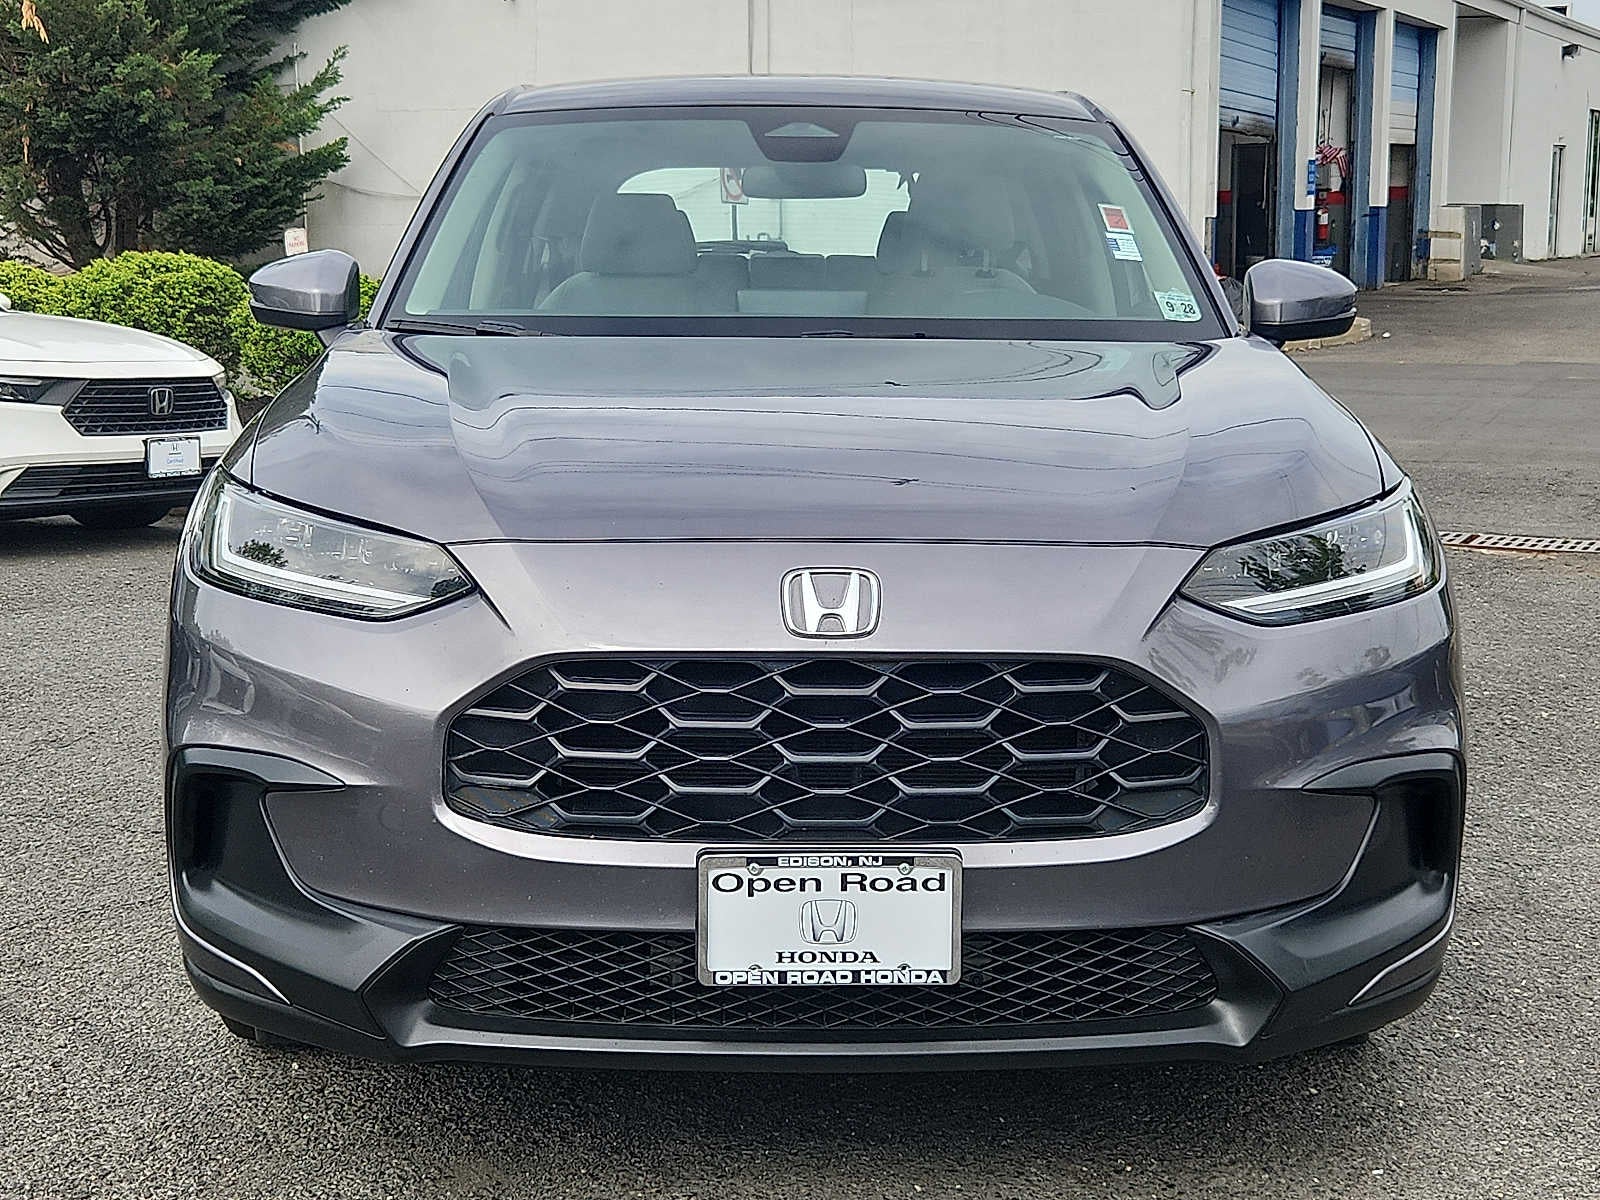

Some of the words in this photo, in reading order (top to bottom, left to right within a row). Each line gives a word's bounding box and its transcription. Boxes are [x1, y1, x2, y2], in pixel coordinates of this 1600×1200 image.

[1165, 300, 1175, 312] 9
[1180, 302, 1196, 315] 28
[777, 856, 853, 867] EDISON,
[858, 856, 883, 867] NJ
[711, 872, 822, 898] Open
[840, 872, 946, 893] Road
[775, 950, 881, 964] HONDA
[714, 970, 779, 985] OPEN
[786, 970, 853, 985] ROAD
[859, 970, 945, 984] HONDA
